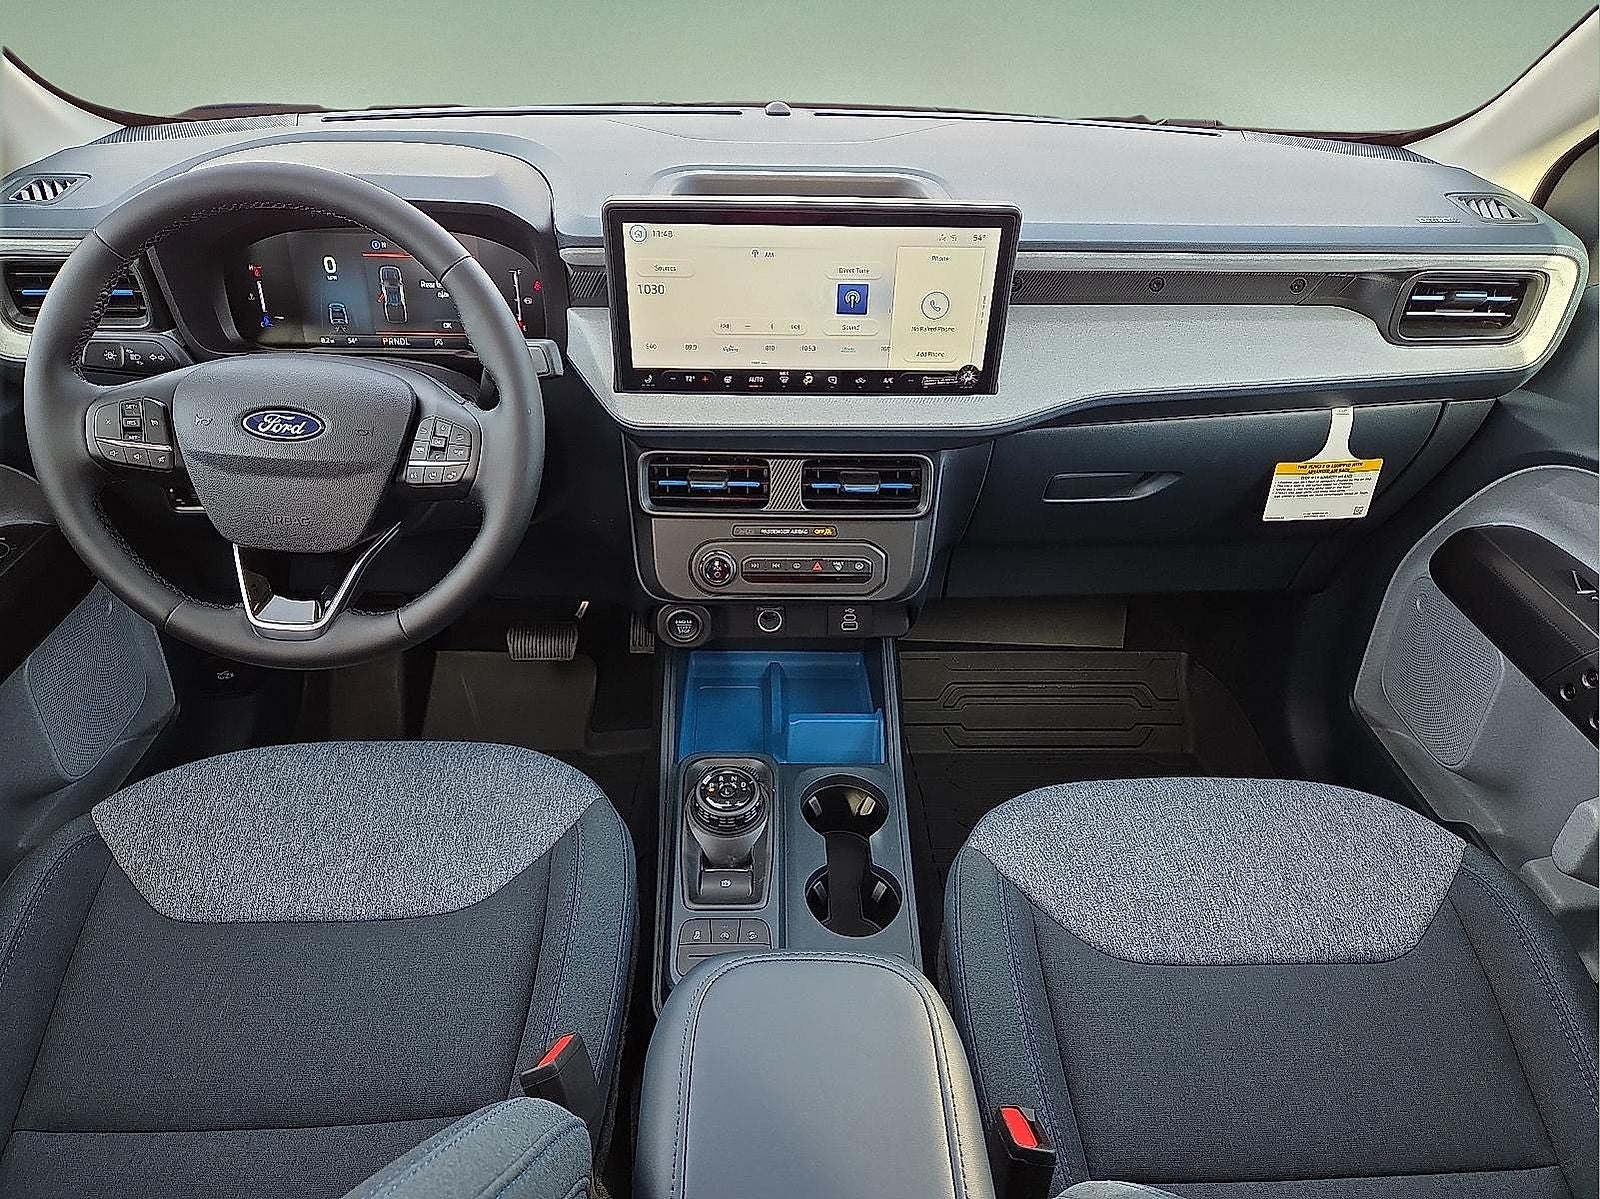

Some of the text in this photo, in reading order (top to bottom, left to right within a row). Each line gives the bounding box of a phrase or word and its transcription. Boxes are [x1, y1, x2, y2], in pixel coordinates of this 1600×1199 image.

[652, 230, 673, 239] 11:48
[323, 255, 338, 274] 0
[420, 280, 436, 288] Rear
[637, 284, 665, 295] 1030
[382, 337, 412, 346] PRNDL
[257, 413, 305, 435] Ford
[262, 514, 312, 527] AIRBAG
